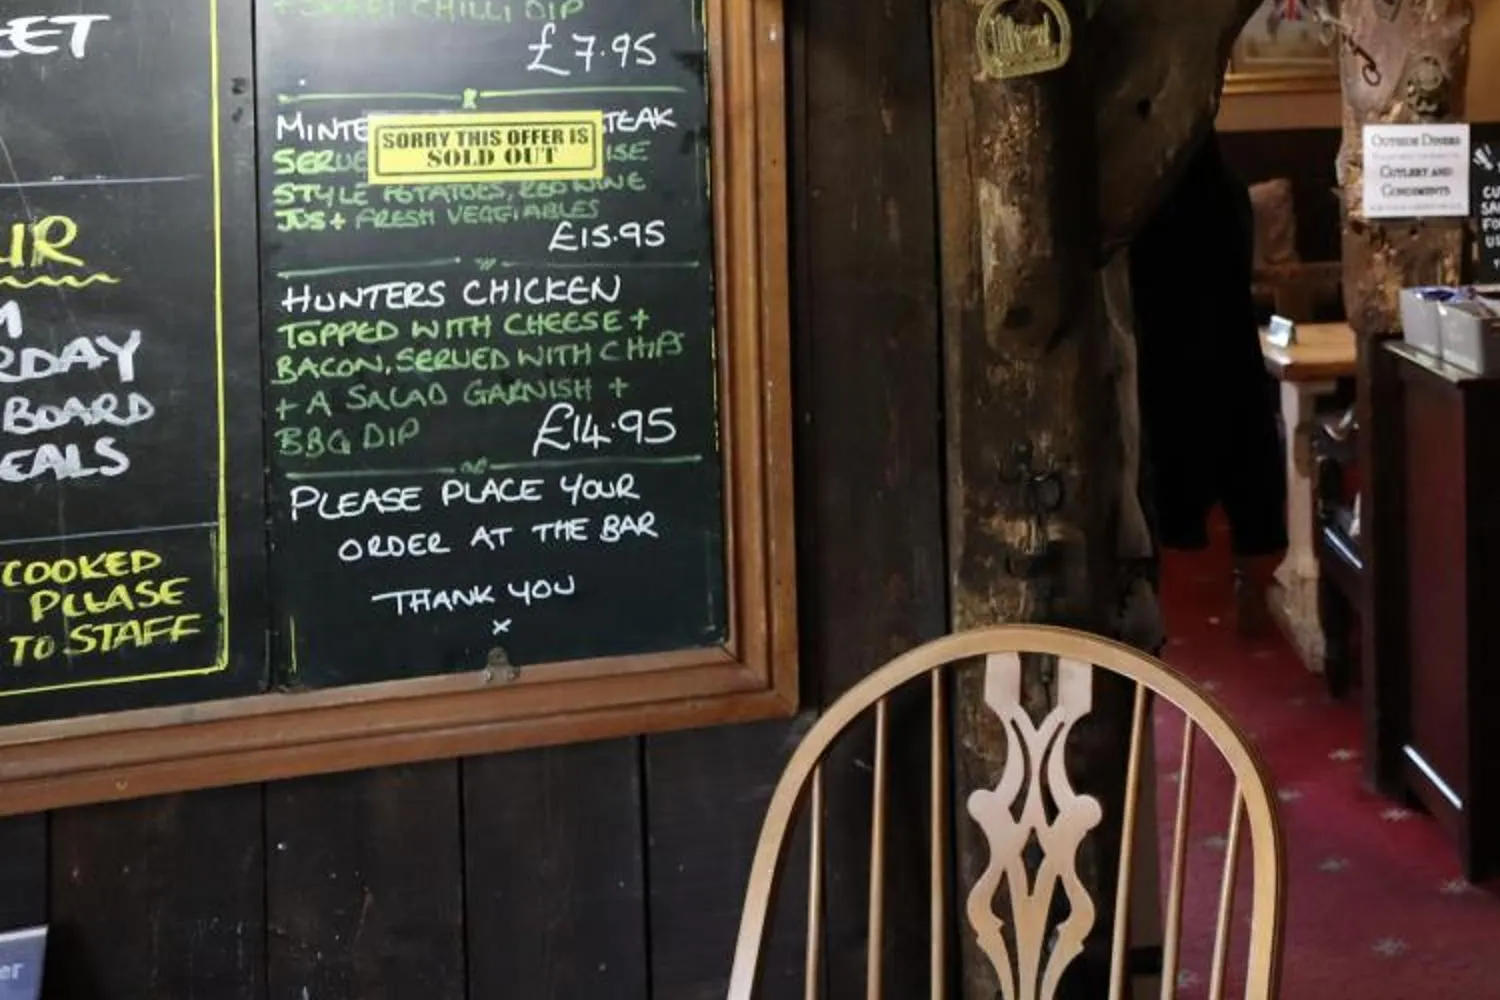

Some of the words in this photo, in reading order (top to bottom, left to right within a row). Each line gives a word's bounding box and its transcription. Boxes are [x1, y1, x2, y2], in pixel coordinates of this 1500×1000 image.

[526, 22, 658, 75] £7.95
[277, 111, 369, 142] MINTE
[603, 106, 677, 133] TEAK
[382, 130, 450, 149] SORRY
[457, 129, 501, 147] THIS
[507, 127, 564, 146] OFFER
[569, 127, 589, 144] IS
[272, 148, 369, 175] SERVE
[427, 148, 495, 168] SOLD
[504, 147, 557, 166] OUT
[272, 182, 369, 207] STYLE
[573, 172, 647, 192] WINE
[355, 207, 435, 230] FRESH
[548, 220, 666, 252] £15.95
[282, 280, 445, 313] HUNTERS
[463, 274, 621, 305] CHICKEN
[278, 319, 399, 349] TOPPED
[411, 315, 492, 338] WITH
[504, 310, 623, 335] CHEESE
[396, 347, 509, 373] SERVED
[517, 343, 592, 368] WITH
[600, 329, 685, 361] CHIPS
[3, 393, 155, 435] BOARD
[307, 390, 331, 416] A
[346, 383, 448, 410] SALAD
[463, 379, 593, 406] GARNISH
[275, 427, 351, 457] BBQ
[363, 418, 420, 448] DIP
[533, 403, 678, 457] £14.95
[291, 485, 423, 520] PLEASE
[441, 478, 544, 507] PLACE
[560, 474, 640, 506] YOUR
[338, 532, 450, 561] ORDER
[471, 526, 513, 550] AT
[532, 518, 589, 543] THE
[599, 511, 659, 542] BAR
[1, 550, 162, 587] COOKED
[29, 577, 191, 624] PLEASE
[371, 586, 495, 615] THANK
[508, 575, 575, 604] YOU
[9, 635, 56, 667] TO
[63, 613, 202, 656] STAFF
